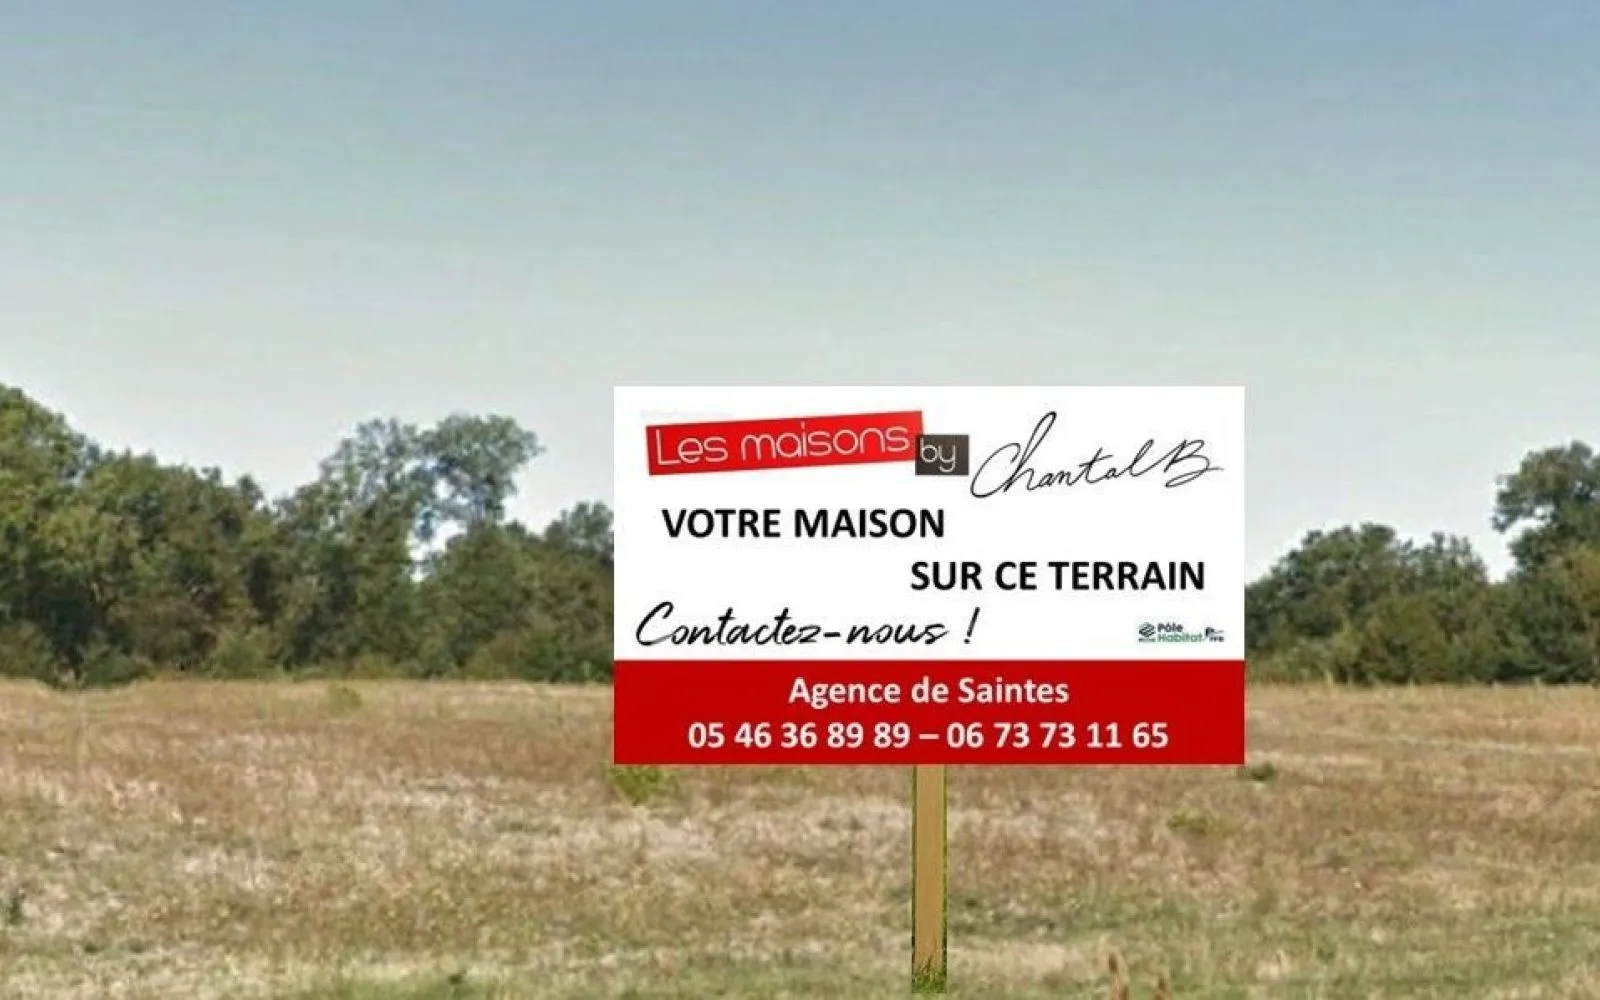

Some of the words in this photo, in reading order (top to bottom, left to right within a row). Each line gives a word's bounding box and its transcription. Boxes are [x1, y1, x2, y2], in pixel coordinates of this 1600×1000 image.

[656, 429, 728, 465] Les
[741, 422, 909, 461] maisons
[919, 440, 956, 472] by
[970, 411, 1155, 498] Chantal
[1162, 439, 1221, 488] B
[662, 509, 780, 538] VOTRE
[795, 509, 944, 538] MAISON
[911, 561, 982, 591] SUR
[995, 561, 1037, 591] CE
[1049, 561, 1204, 591] TERRAIN
[635, 601, 948, 646] Contactez-nous
[964, 607, 980, 645] !
[1157, 633, 1203, 643] Habitat
[789, 677, 901, 709] Agence
[911, 676, 948, 703] de
[958, 676, 1069, 703] Saintes
[688, 722, 725, 748] 05
[734, 722, 772, 748] 46
[781, 722, 818, 748] 36
[827, 722, 864, 748] 89
[874, 722, 911, 748] 89
[946, 722, 984, 748] 06
[994, 722, 1030, 748] 73
[1040, 722, 1076, 748] 73
[1087, 722, 1122, 748] 11
[1132, 722, 1169, 748] 65
